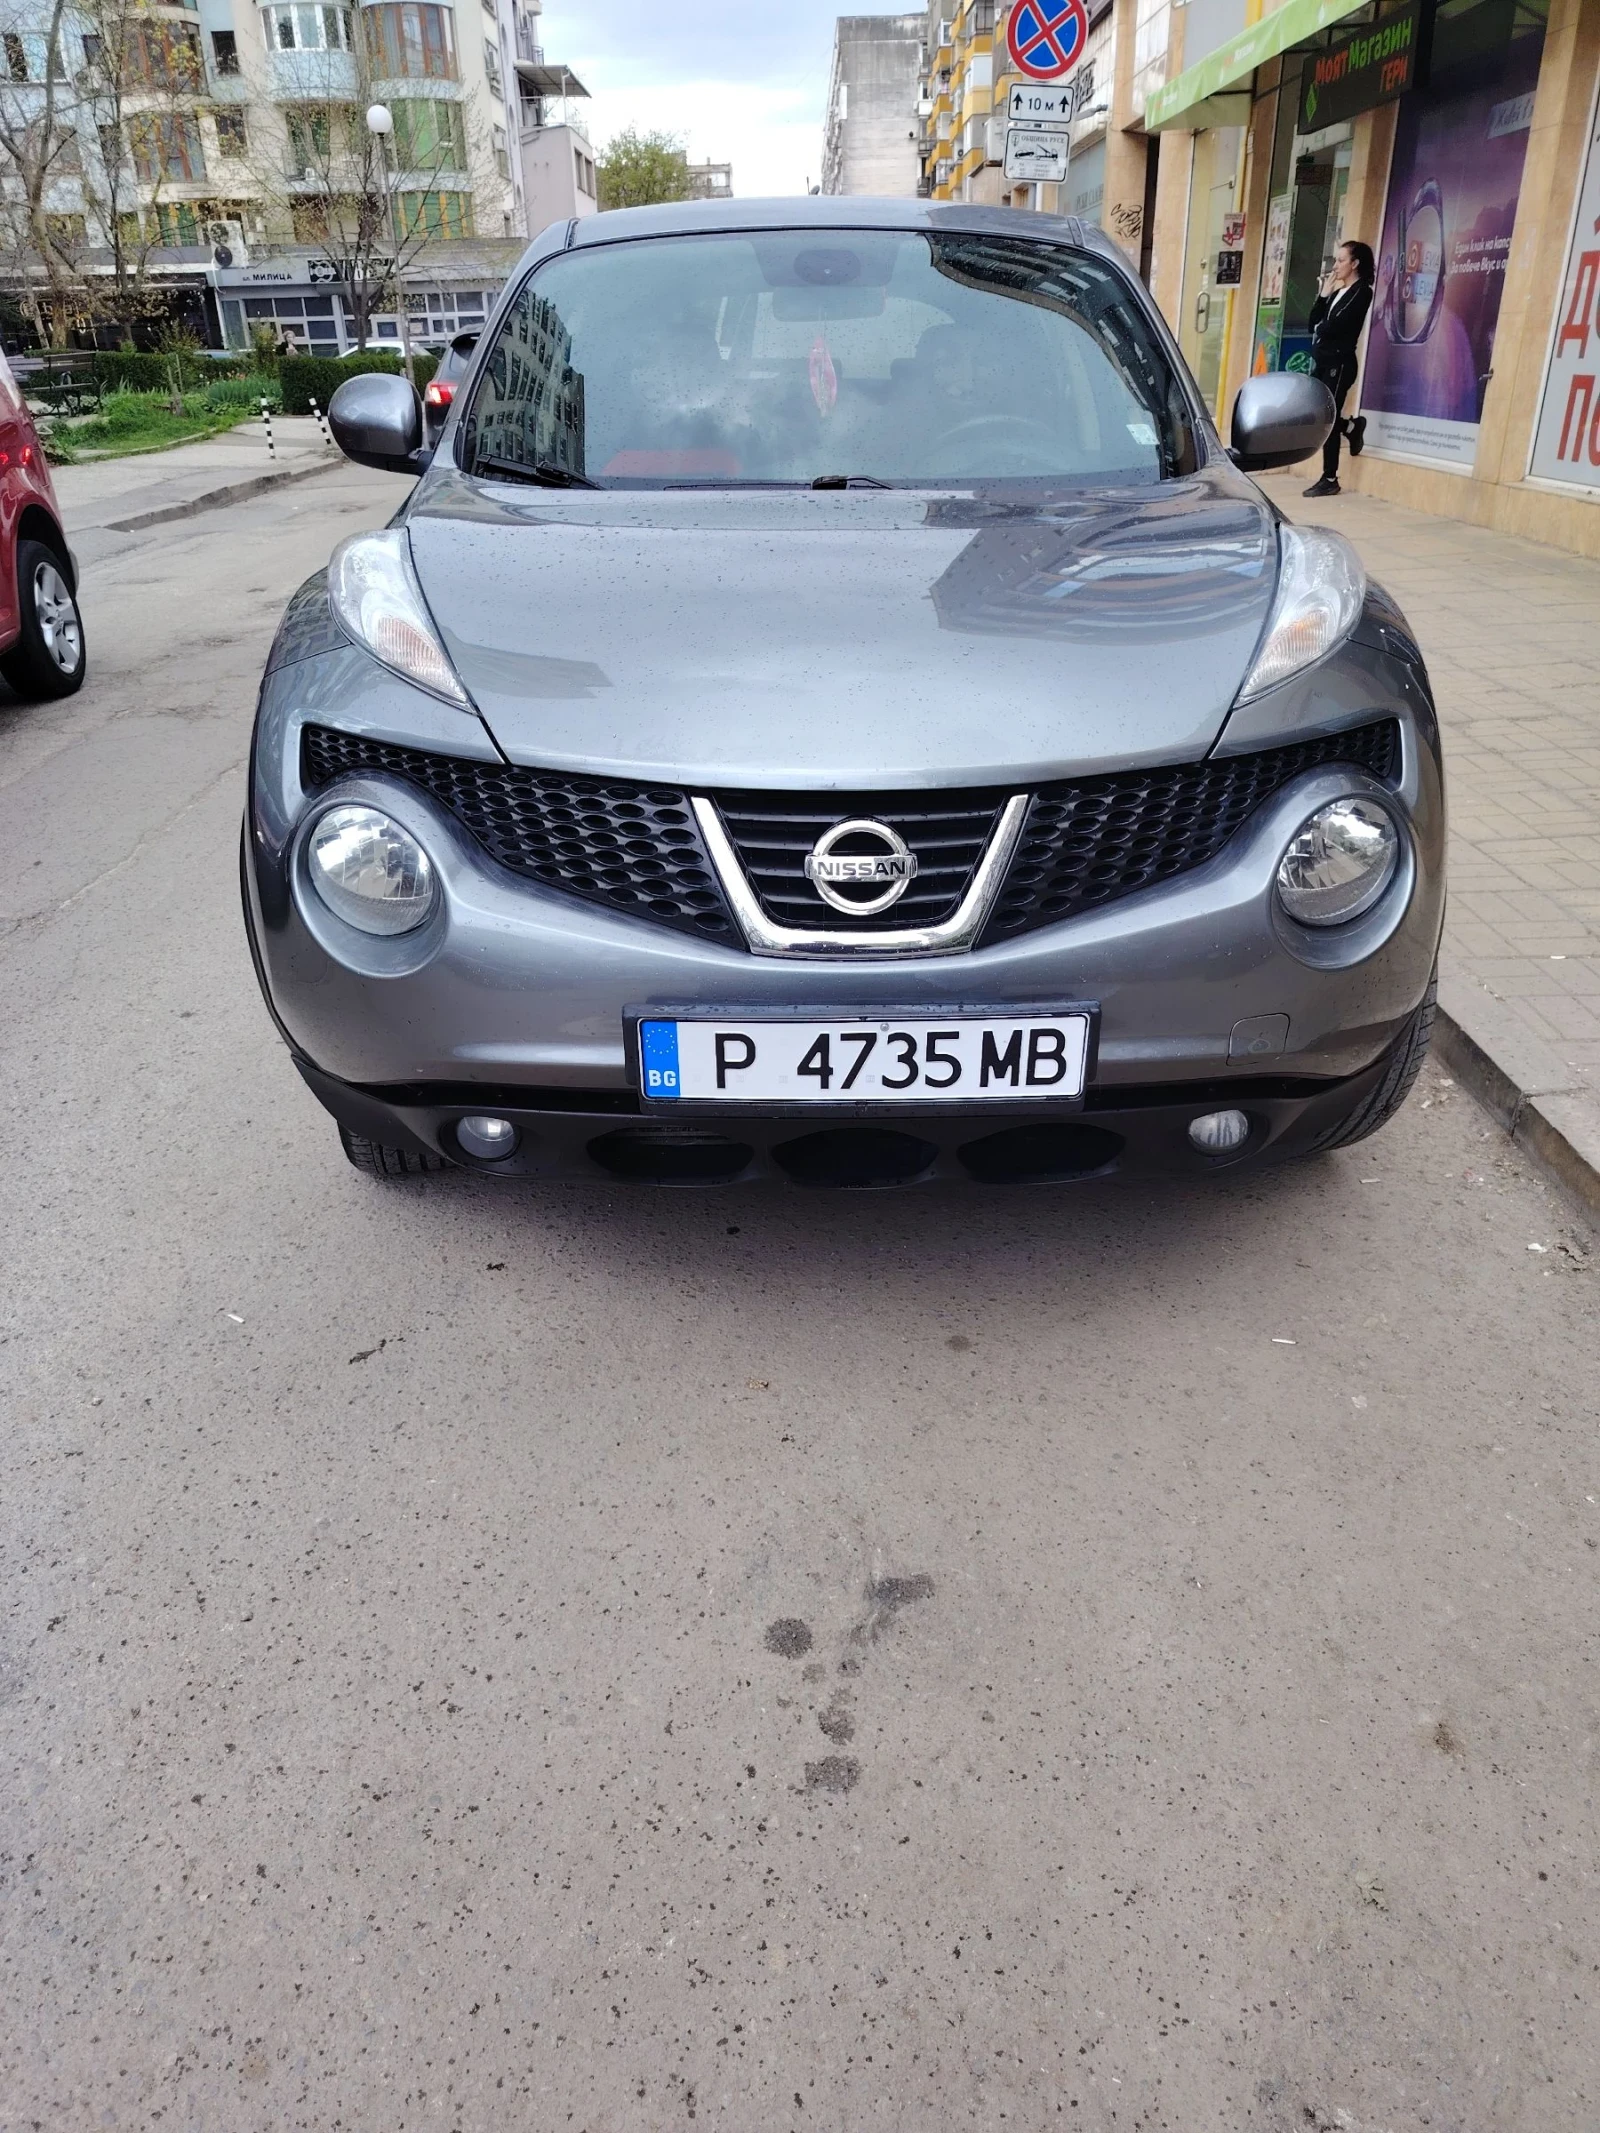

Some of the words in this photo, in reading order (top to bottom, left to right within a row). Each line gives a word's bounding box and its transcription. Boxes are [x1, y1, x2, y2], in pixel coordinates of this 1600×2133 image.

[1379, 55, 1409, 93] ГЕРИ
[1028, 97, 1042, 111] 10
[252, 273, 293, 281] МИЛИЦА
[817, 861, 906, 876] NISSAN
[797, 1031, 962, 1089] 4735
[649, 1070, 677, 1087] BG
